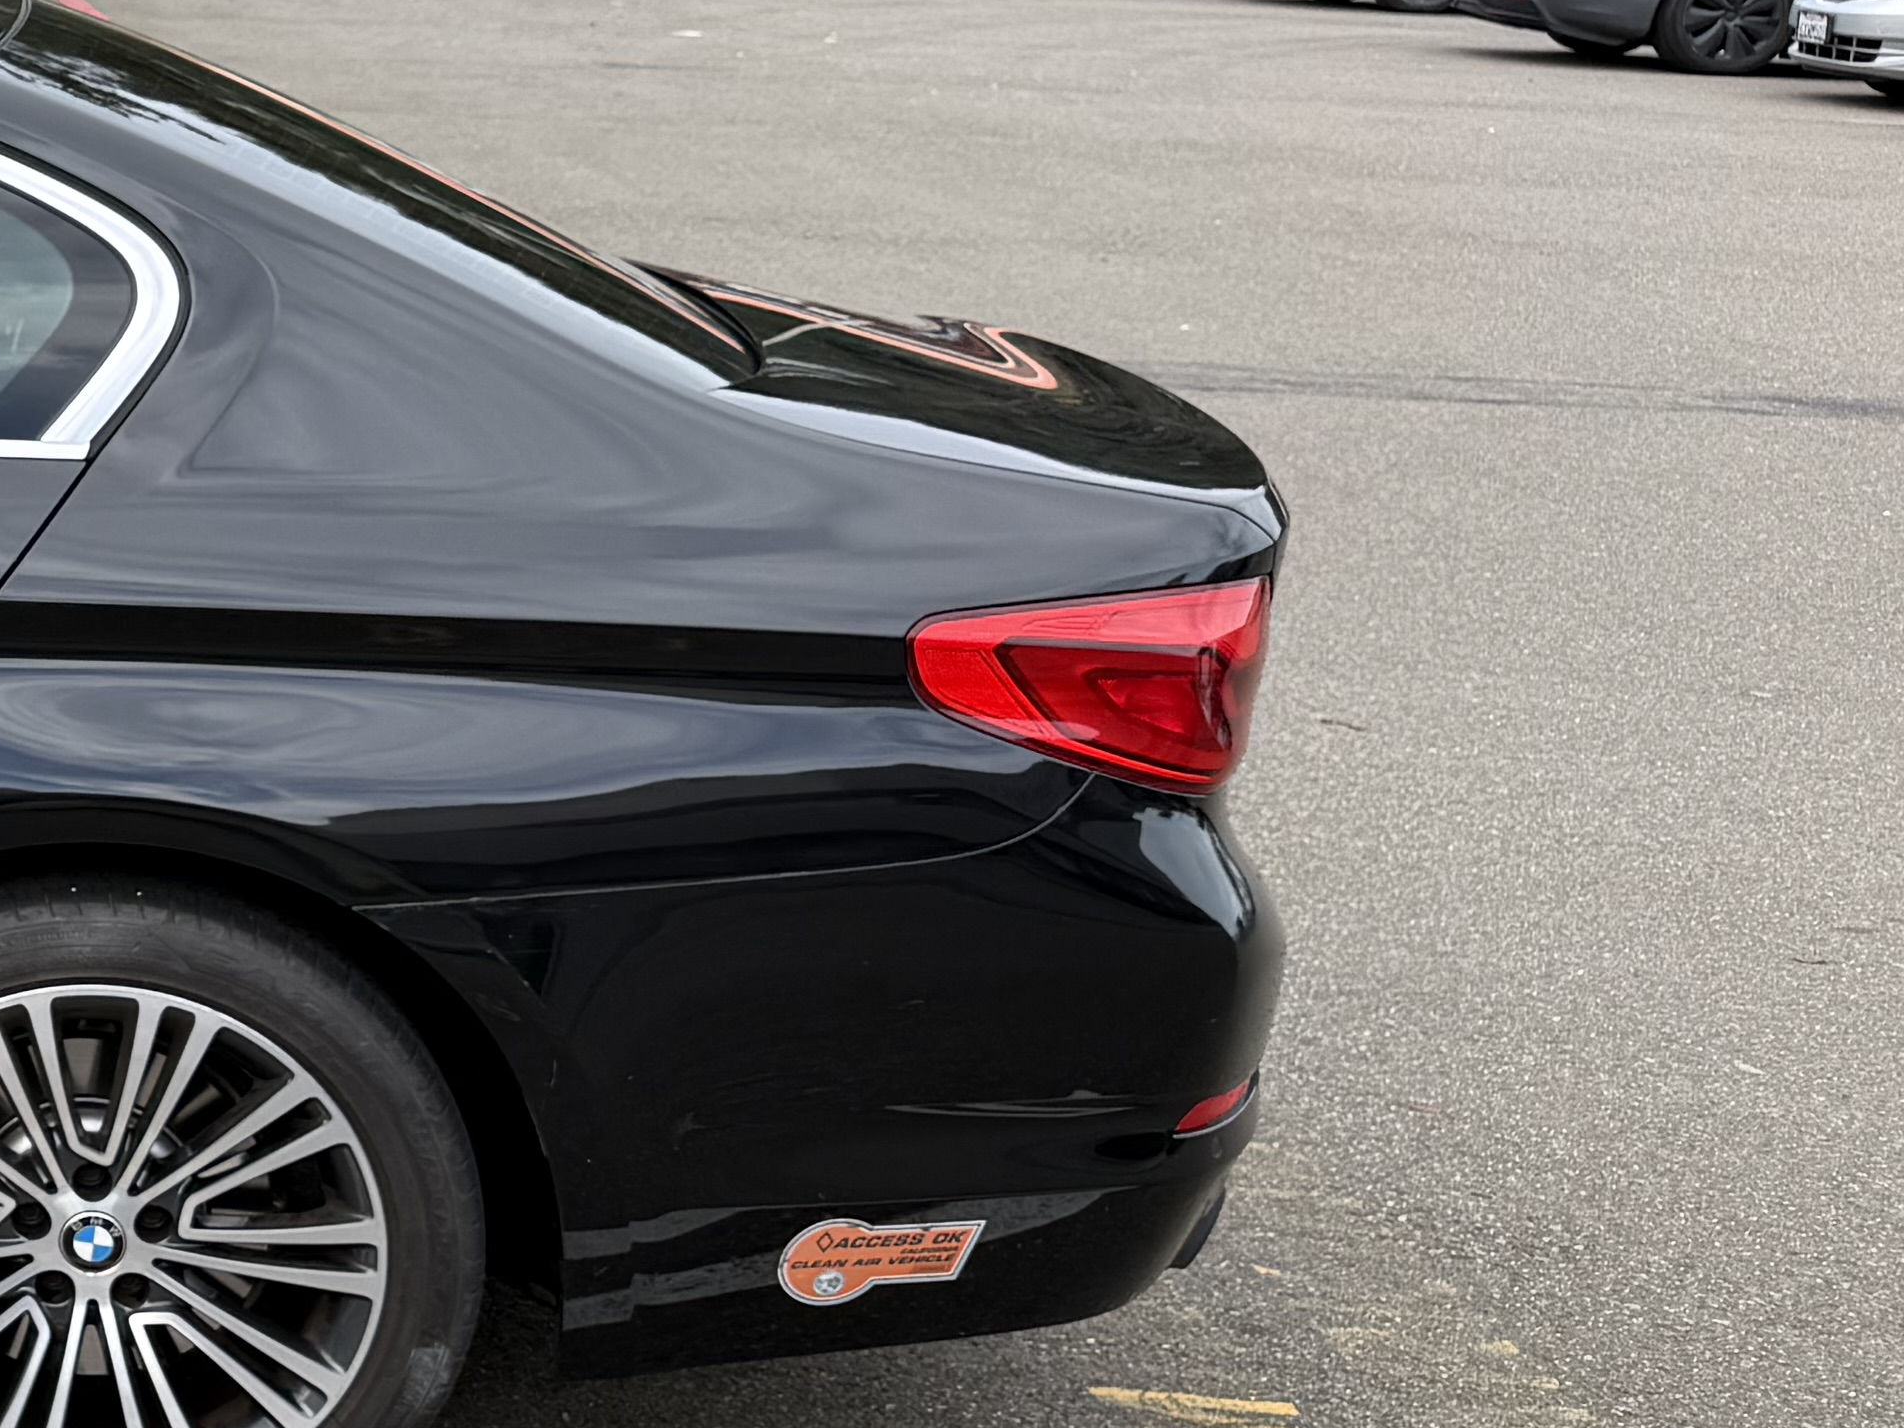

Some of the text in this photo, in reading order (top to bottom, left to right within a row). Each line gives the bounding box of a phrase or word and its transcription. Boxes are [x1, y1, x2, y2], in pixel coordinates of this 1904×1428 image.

[833, 1231, 968, 1249] ACCESS OK
[792, 1253, 955, 1270] CLEAN AIR VEHICLE
